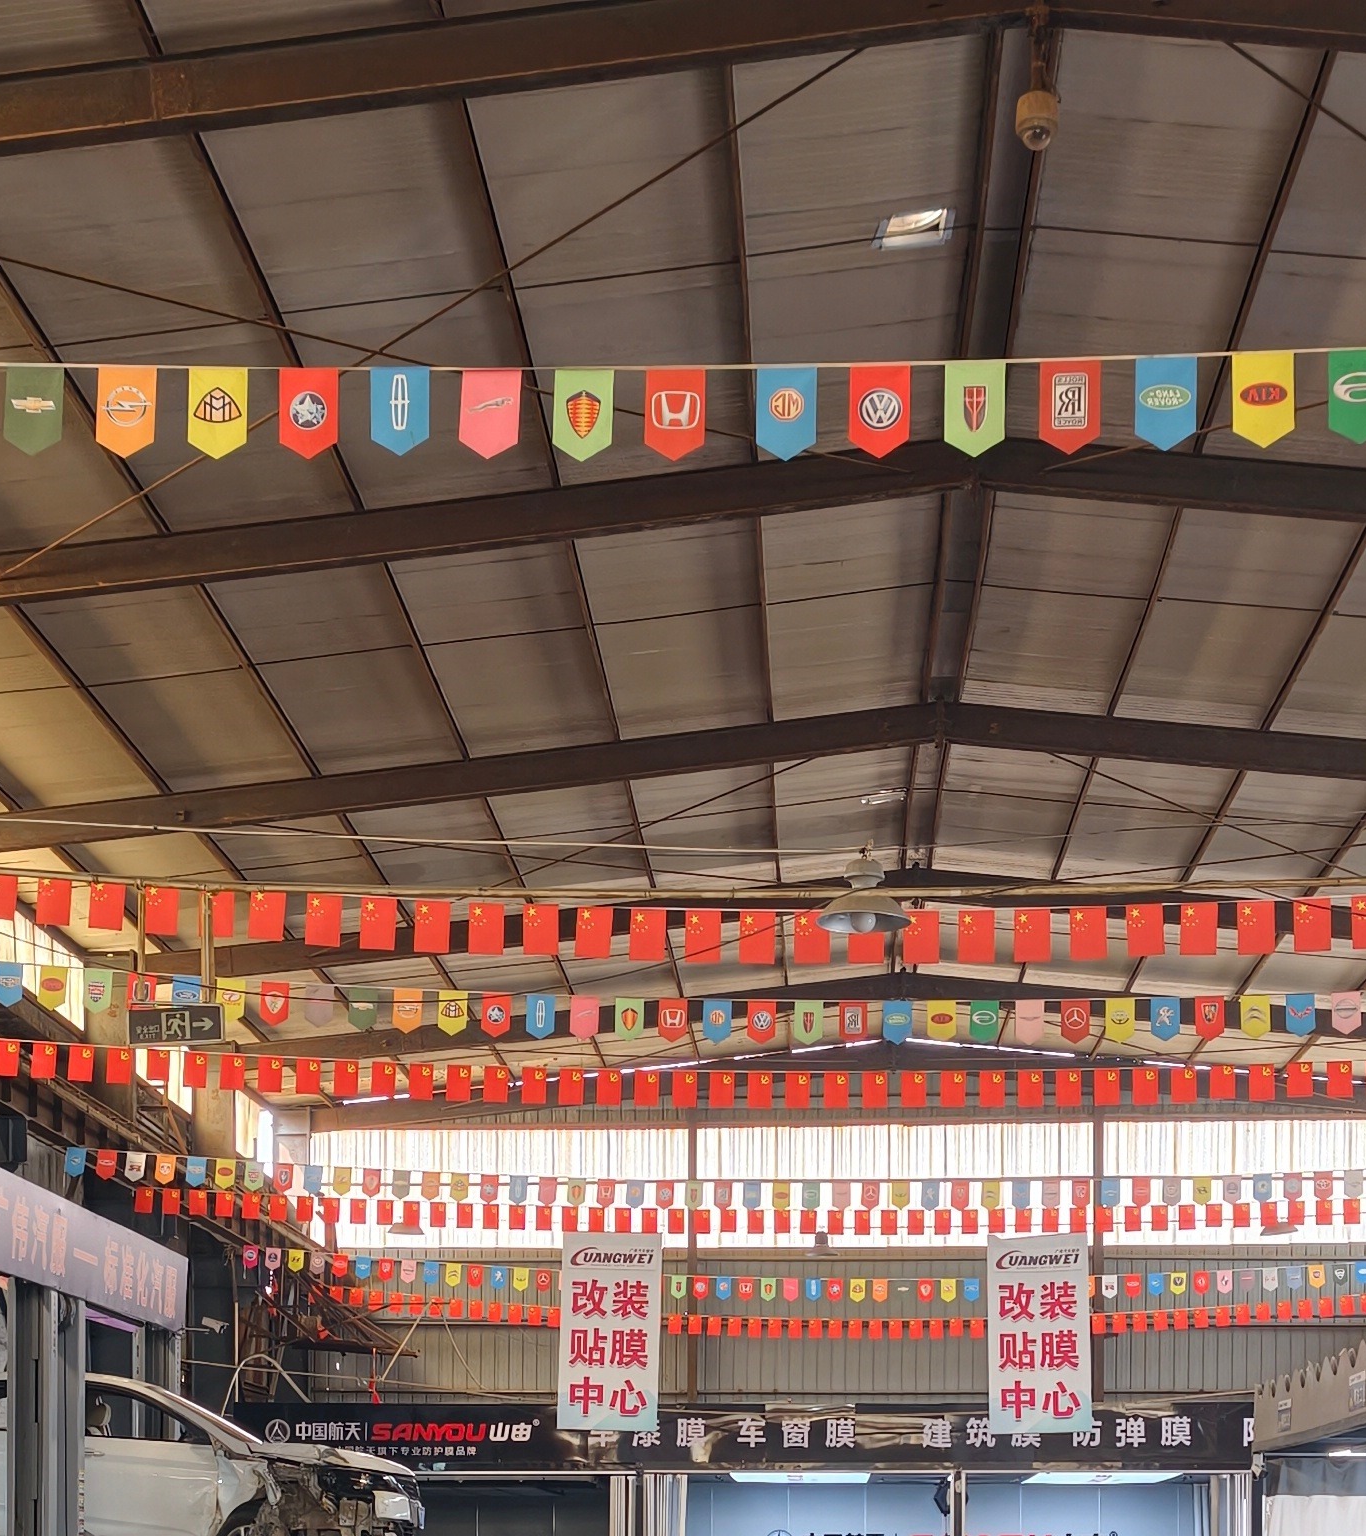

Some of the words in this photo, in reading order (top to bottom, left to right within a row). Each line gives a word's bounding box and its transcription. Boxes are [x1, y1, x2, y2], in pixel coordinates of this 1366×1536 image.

[571, 1278, 650, 1318] 改装
[998, 1281, 1077, 1322] 改装
[569, 1327, 649, 1368] 贴膜
[998, 1330, 1080, 1371] 贴膜
[569, 1376, 648, 1416] 中心
[1000, 1380, 1081, 1419] 中心
[295, 1421, 361, 1441] 中国航天
[370, 1423, 487, 1442] SANYOU
[488, 1422, 533, 1442] 山由
[736, 1417, 857, 1448] 车窗膜
[1072, 1416, 1192, 1448] 防弹膜
